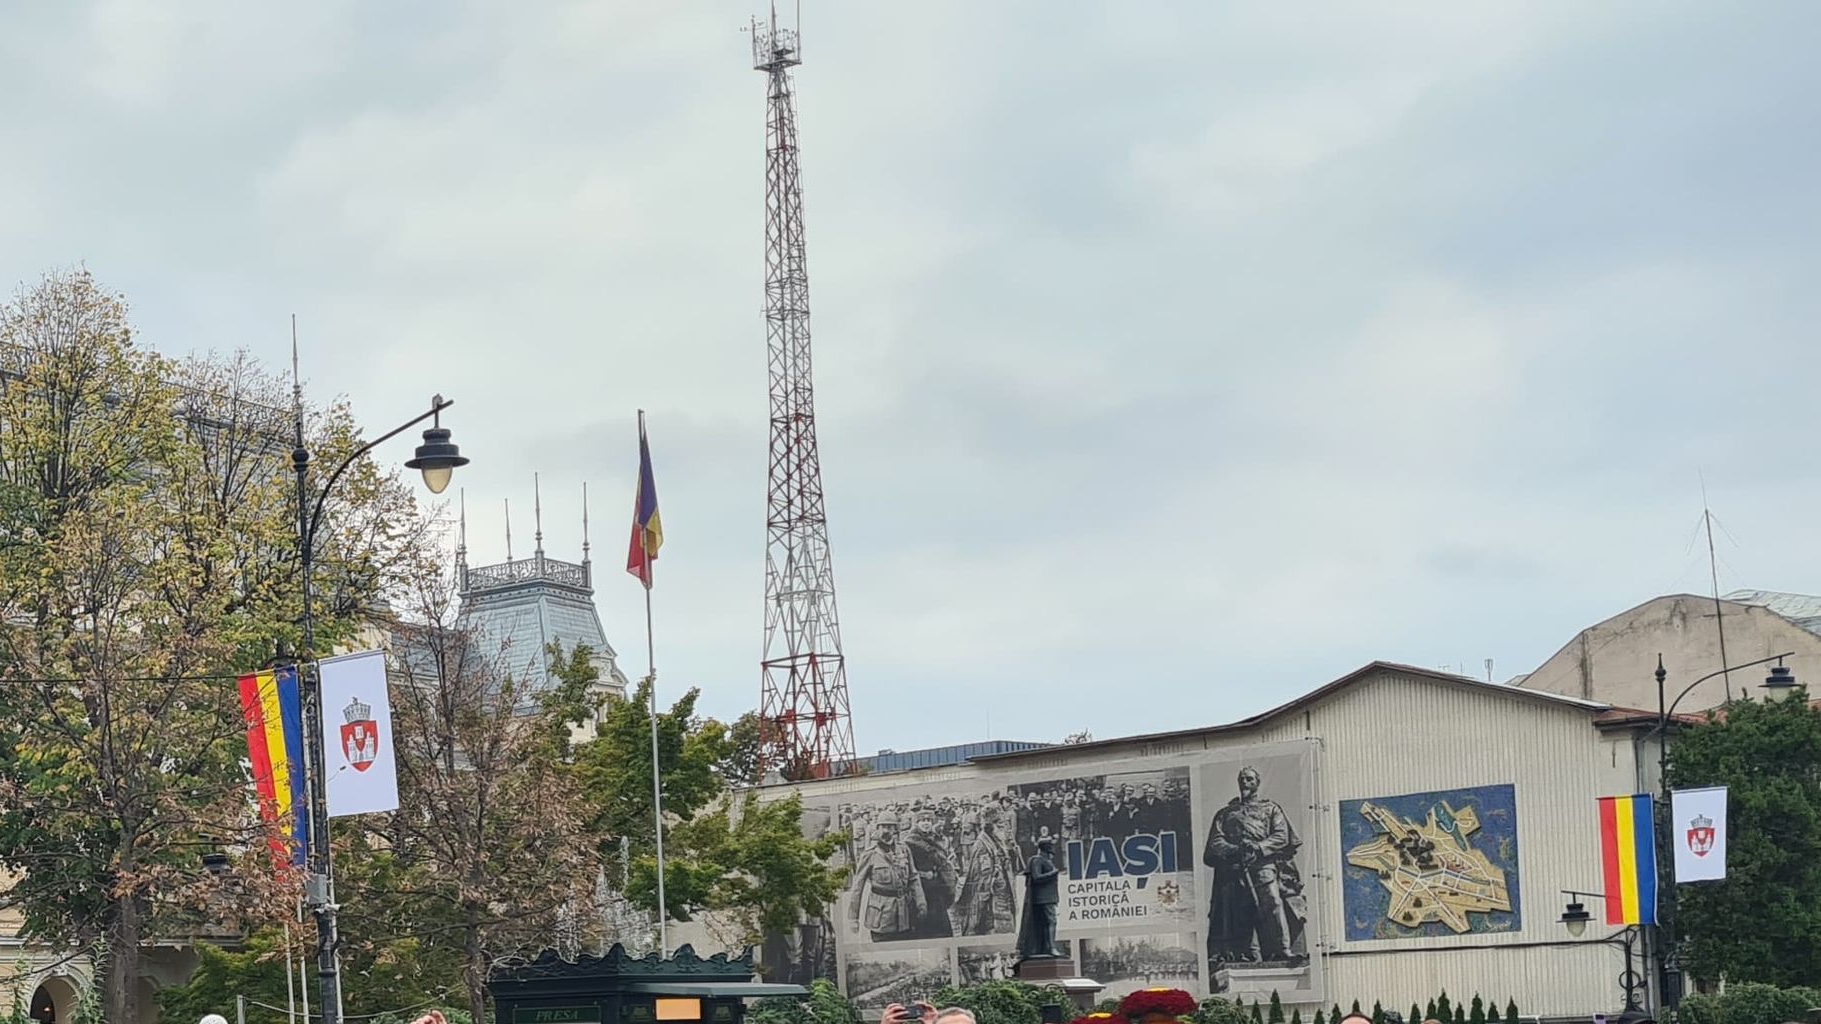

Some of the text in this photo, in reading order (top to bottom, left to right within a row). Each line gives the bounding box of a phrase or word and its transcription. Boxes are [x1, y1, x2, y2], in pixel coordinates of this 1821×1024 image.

[1066, 830, 1178, 890] IAȘI
[1067, 879, 1131, 895] CAPITALA
[1068, 891, 1130, 908] ISTORICĂ
[1068, 904, 1148, 921] A ROMÂNIEI
[536, 1010, 579, 1021] PRESA
